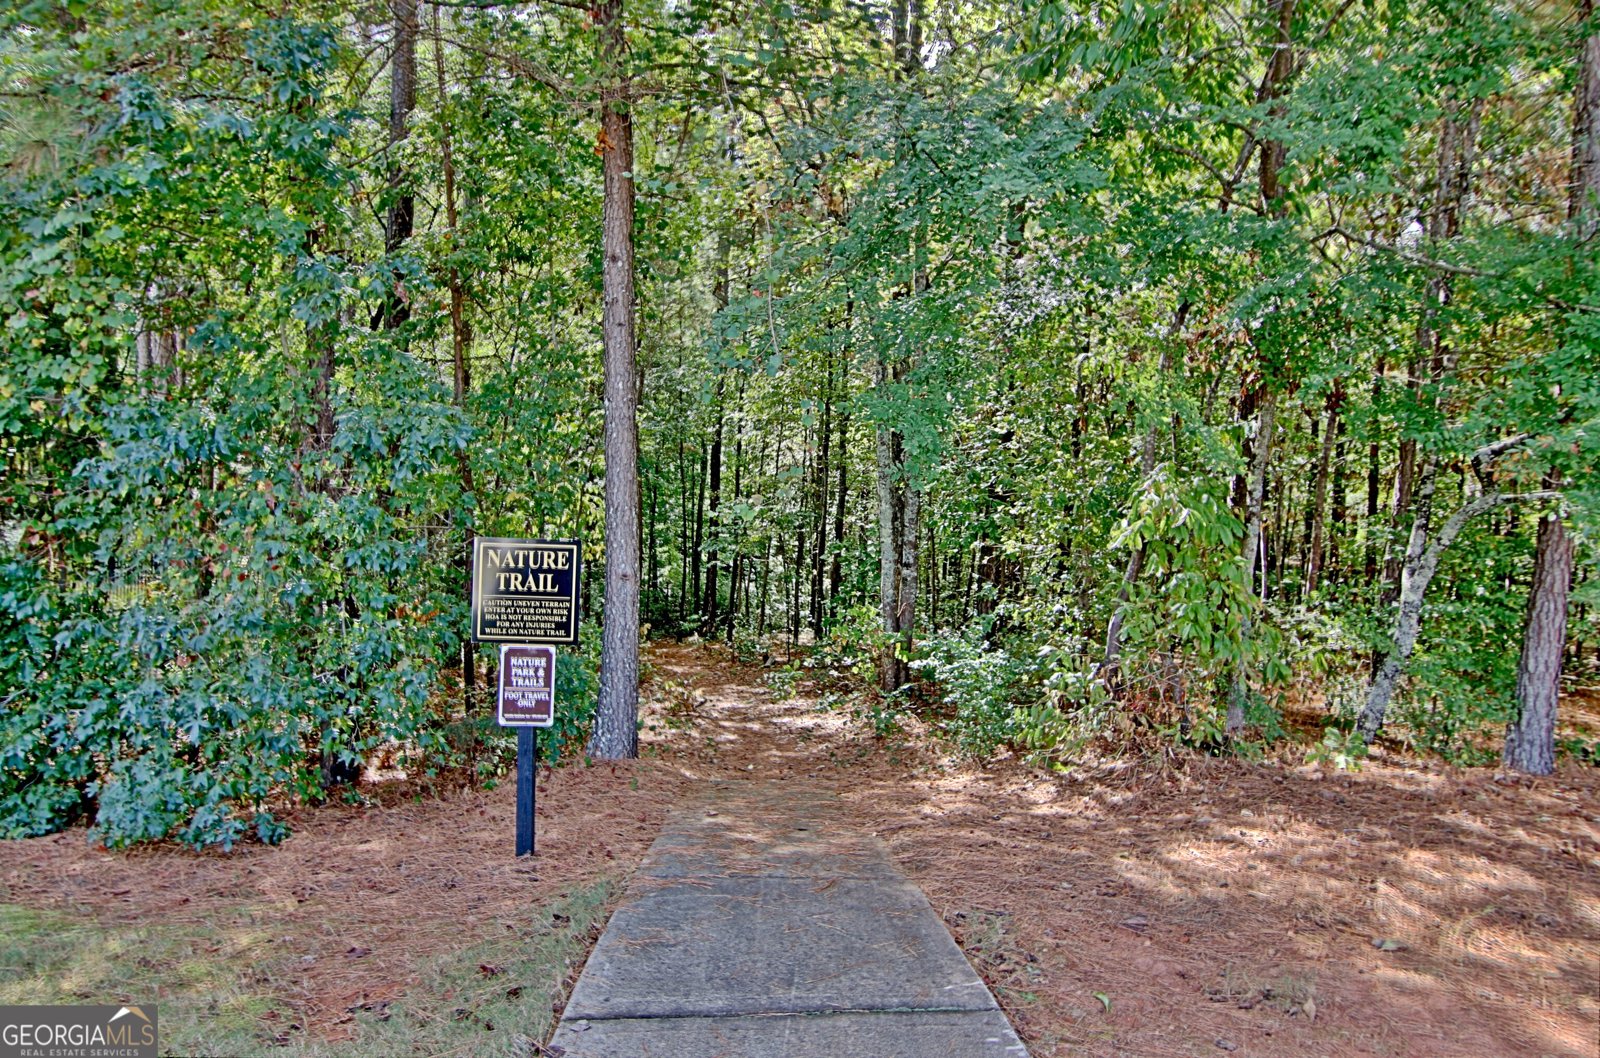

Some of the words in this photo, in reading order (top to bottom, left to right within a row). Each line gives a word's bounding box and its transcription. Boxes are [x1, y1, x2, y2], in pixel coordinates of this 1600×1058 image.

[487, 549, 569, 570] NATURE
[496, 572, 559, 592] TRAIL
[510, 657, 546, 667] NATURE
[511, 667, 535, 677] PARK
[537, 669, 544, 678] &
[511, 677, 544, 687] TRAILS
[505, 692, 523, 700] FOOT
[524, 692, 549, 700] TRAVEL
